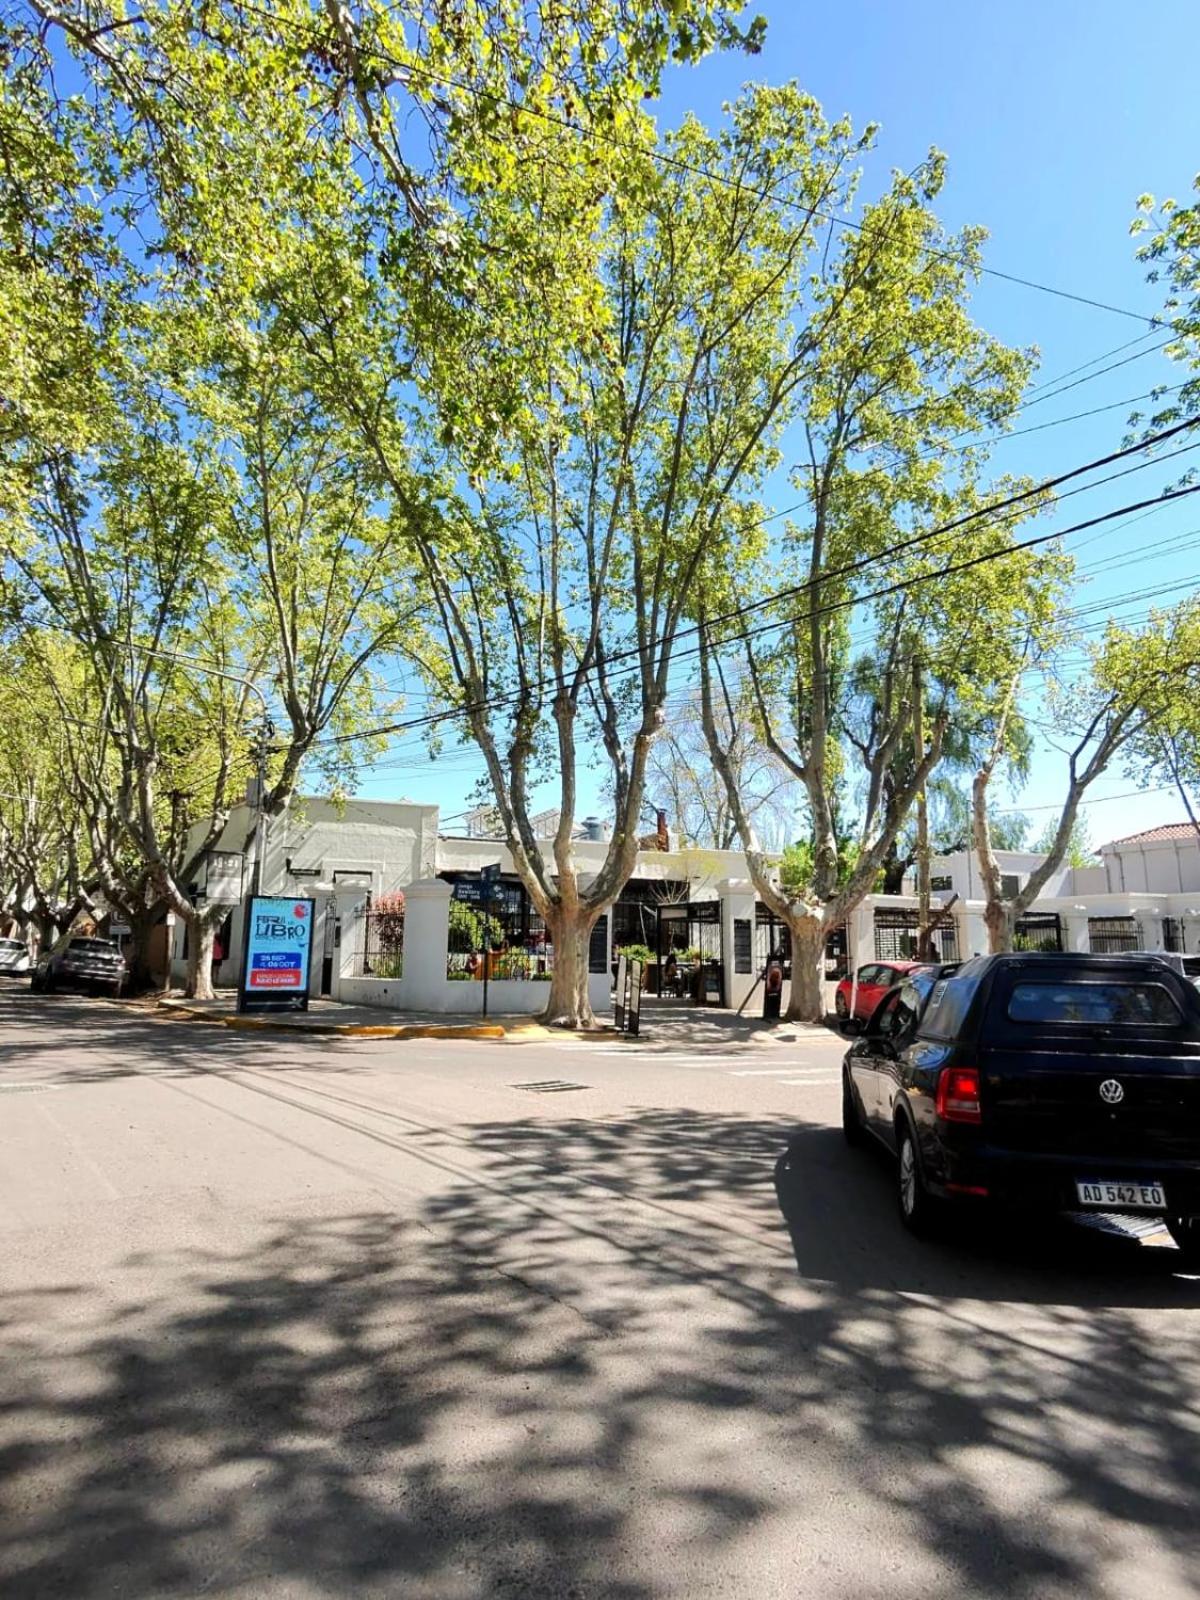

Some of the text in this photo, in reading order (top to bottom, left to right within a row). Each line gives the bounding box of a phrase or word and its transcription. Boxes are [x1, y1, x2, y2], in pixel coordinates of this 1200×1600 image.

[256, 924, 306, 939] LIBRO
[1083, 1186, 1161, 1204] AD 542 EO
